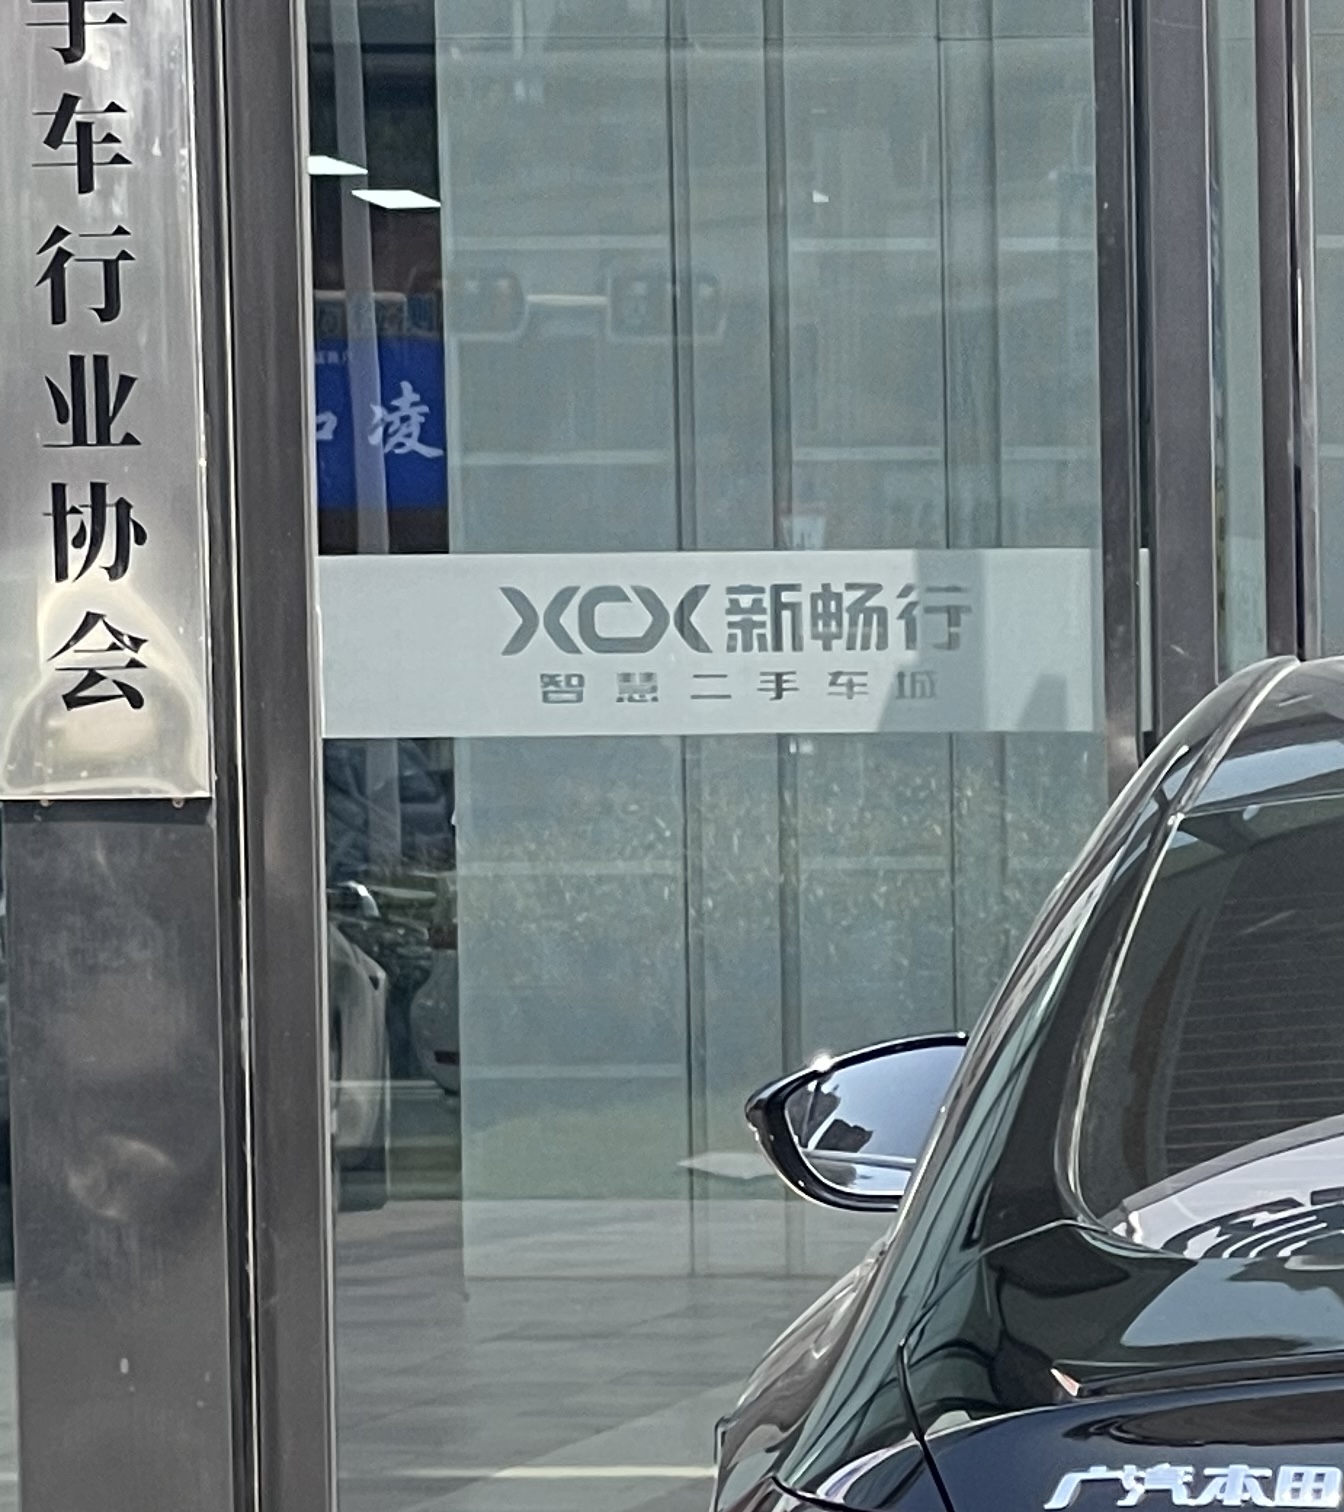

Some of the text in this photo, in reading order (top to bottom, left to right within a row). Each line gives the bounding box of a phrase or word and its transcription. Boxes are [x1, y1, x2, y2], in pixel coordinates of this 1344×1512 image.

[26, 0, 148, 712] 手车行业协会
[725, 583, 973, 652] 新畅行
[539, 670, 938, 704] 智慧二手车城
[1043, 1463, 1344, 1510] 广汽本田
